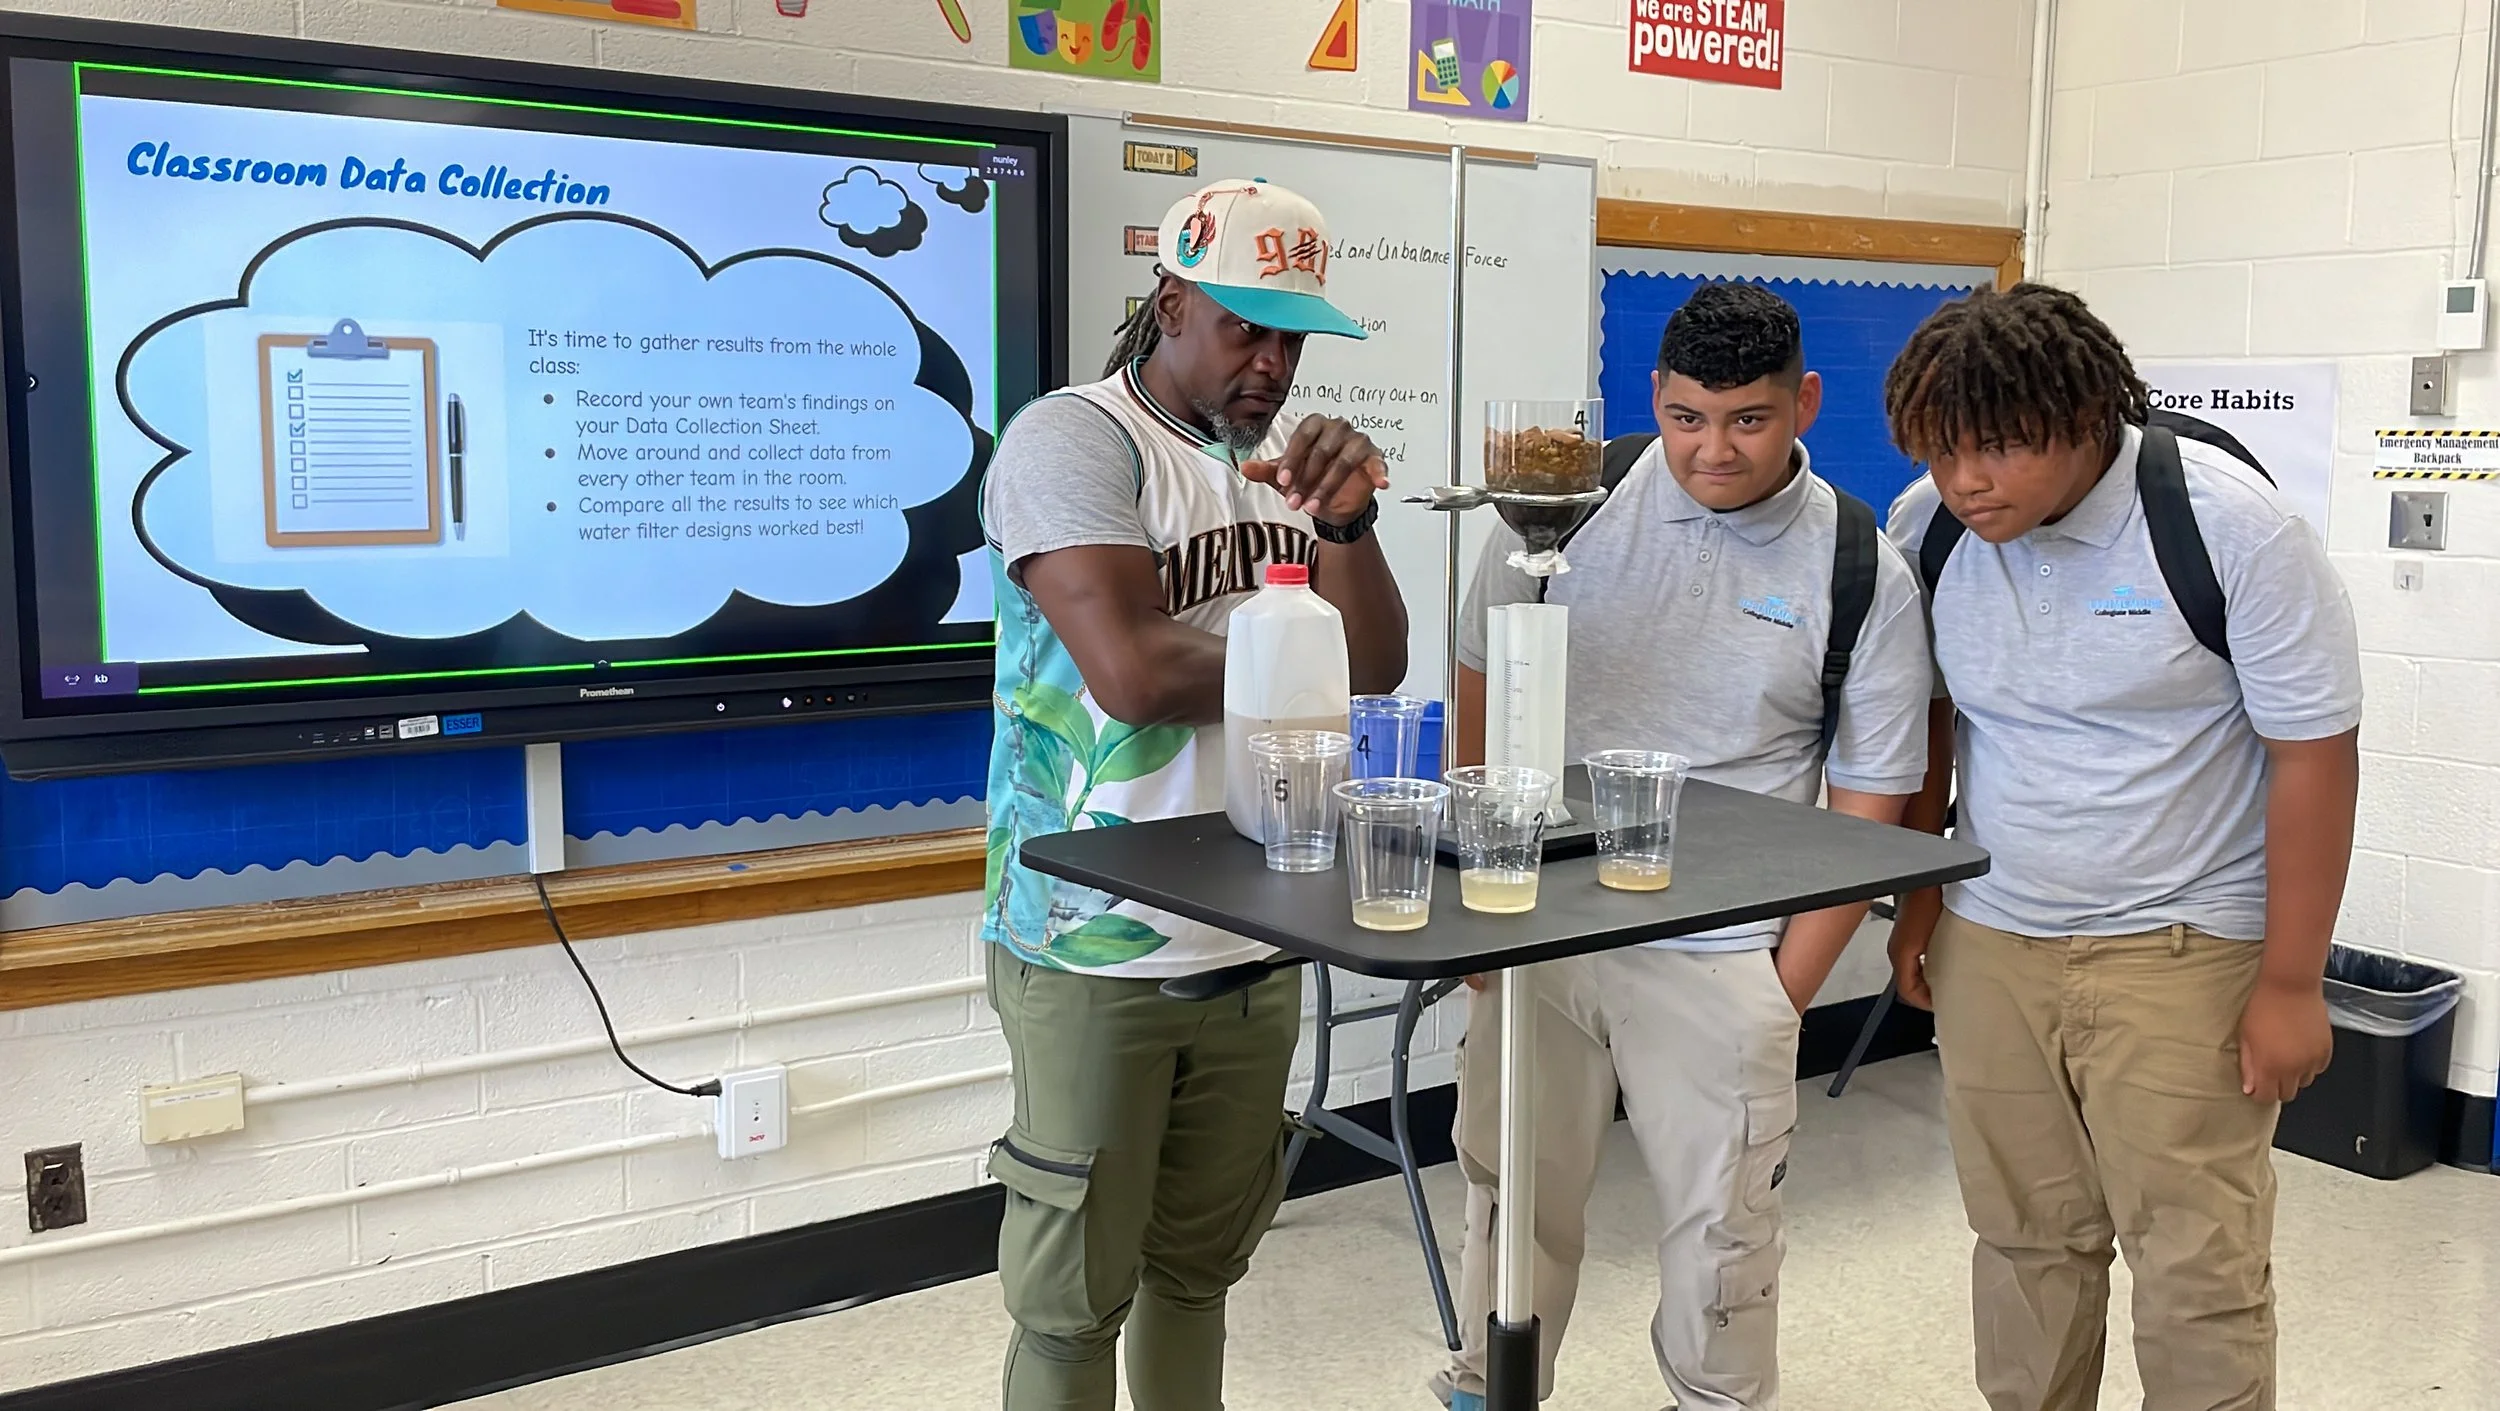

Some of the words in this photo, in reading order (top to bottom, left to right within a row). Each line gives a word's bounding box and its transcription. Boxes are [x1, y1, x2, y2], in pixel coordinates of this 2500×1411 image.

[1636, 0, 1660, 20] We
[1663, 2, 1694, 24] are
[1696, 0, 1768, 33] STEAM
[1634, 21, 1780, 72] powered!
[992, 155, 1019, 167] nunley
[1136, 149, 1165, 165] TODAY
[126, 140, 328, 188] Classroom
[339, 155, 427, 195] Data
[437, 163, 611, 206] Collection
[1349, 242, 1374, 261] and
[1465, 245, 1508, 269] Forces
[528, 328, 558, 348] It's
[563, 329, 608, 349] time
[613, 331, 632, 349] to
[640, 333, 700, 354] gather
[706, 336, 764, 354] results
[769, 337, 812, 355] from
[816, 338, 845, 356] the
[850, 340, 897, 357] whole
[529, 356, 580, 375] class:
[576, 389, 643, 408] Record
[649, 394, 692, 413] your
[698, 395, 733, 409] own
[739, 393, 796, 410] team's
[801, 393, 868, 414] findings
[874, 397, 895, 411] on
[1316, 384, 1342, 404] and
[1389, 387, 1417, 402] out
[1420, 391, 1438, 405] an
[2147, 389, 2203, 409] Core
[2210, 389, 2295, 410] Habits
[575, 419, 620, 438] your
[626, 416, 668, 435] Data
[675, 417, 762, 435] Collection
[769, 418, 820, 435] Sheet.
[1574, 410, 1588, 431] 4
[577, 443, 629, 461] Move
[635, 443, 700, 461] around
[707, 444, 741, 461] and
[748, 443, 803, 461] collect
[809, 444, 845, 461] data
[851, 444, 891, 461] from
[2379, 436, 2432, 450] Emergency
[2435, 437, 2499, 450] Management
[2414, 452, 2462, 465] Backpack
[577, 473, 629, 491] every
[635, 469, 685, 487] other
[690, 470, 735, 487] team
[742, 469, 759, 486] in
[764, 469, 792, 486] the
[799, 471, 847, 486] room.
[578, 496, 665, 517] Compare
[671, 495, 691, 513] all
[697, 495, 727, 512] the
[734, 494, 790, 512] results
[795, 496, 813, 511] to
[818, 496, 848, 511] see
[853, 493, 899, 511] which
[578, 523, 631, 541] water
[636, 521, 680, 540] filter
[685, 520, 752, 542] designs
[758, 519, 819, 537] worked
[826, 518, 864, 536] best!
[94, 673, 109, 684] kb
[580, 686, 635, 698] Promethean
[446, 716, 481, 732] ESSER
[1357, 735, 1372, 761] 4
